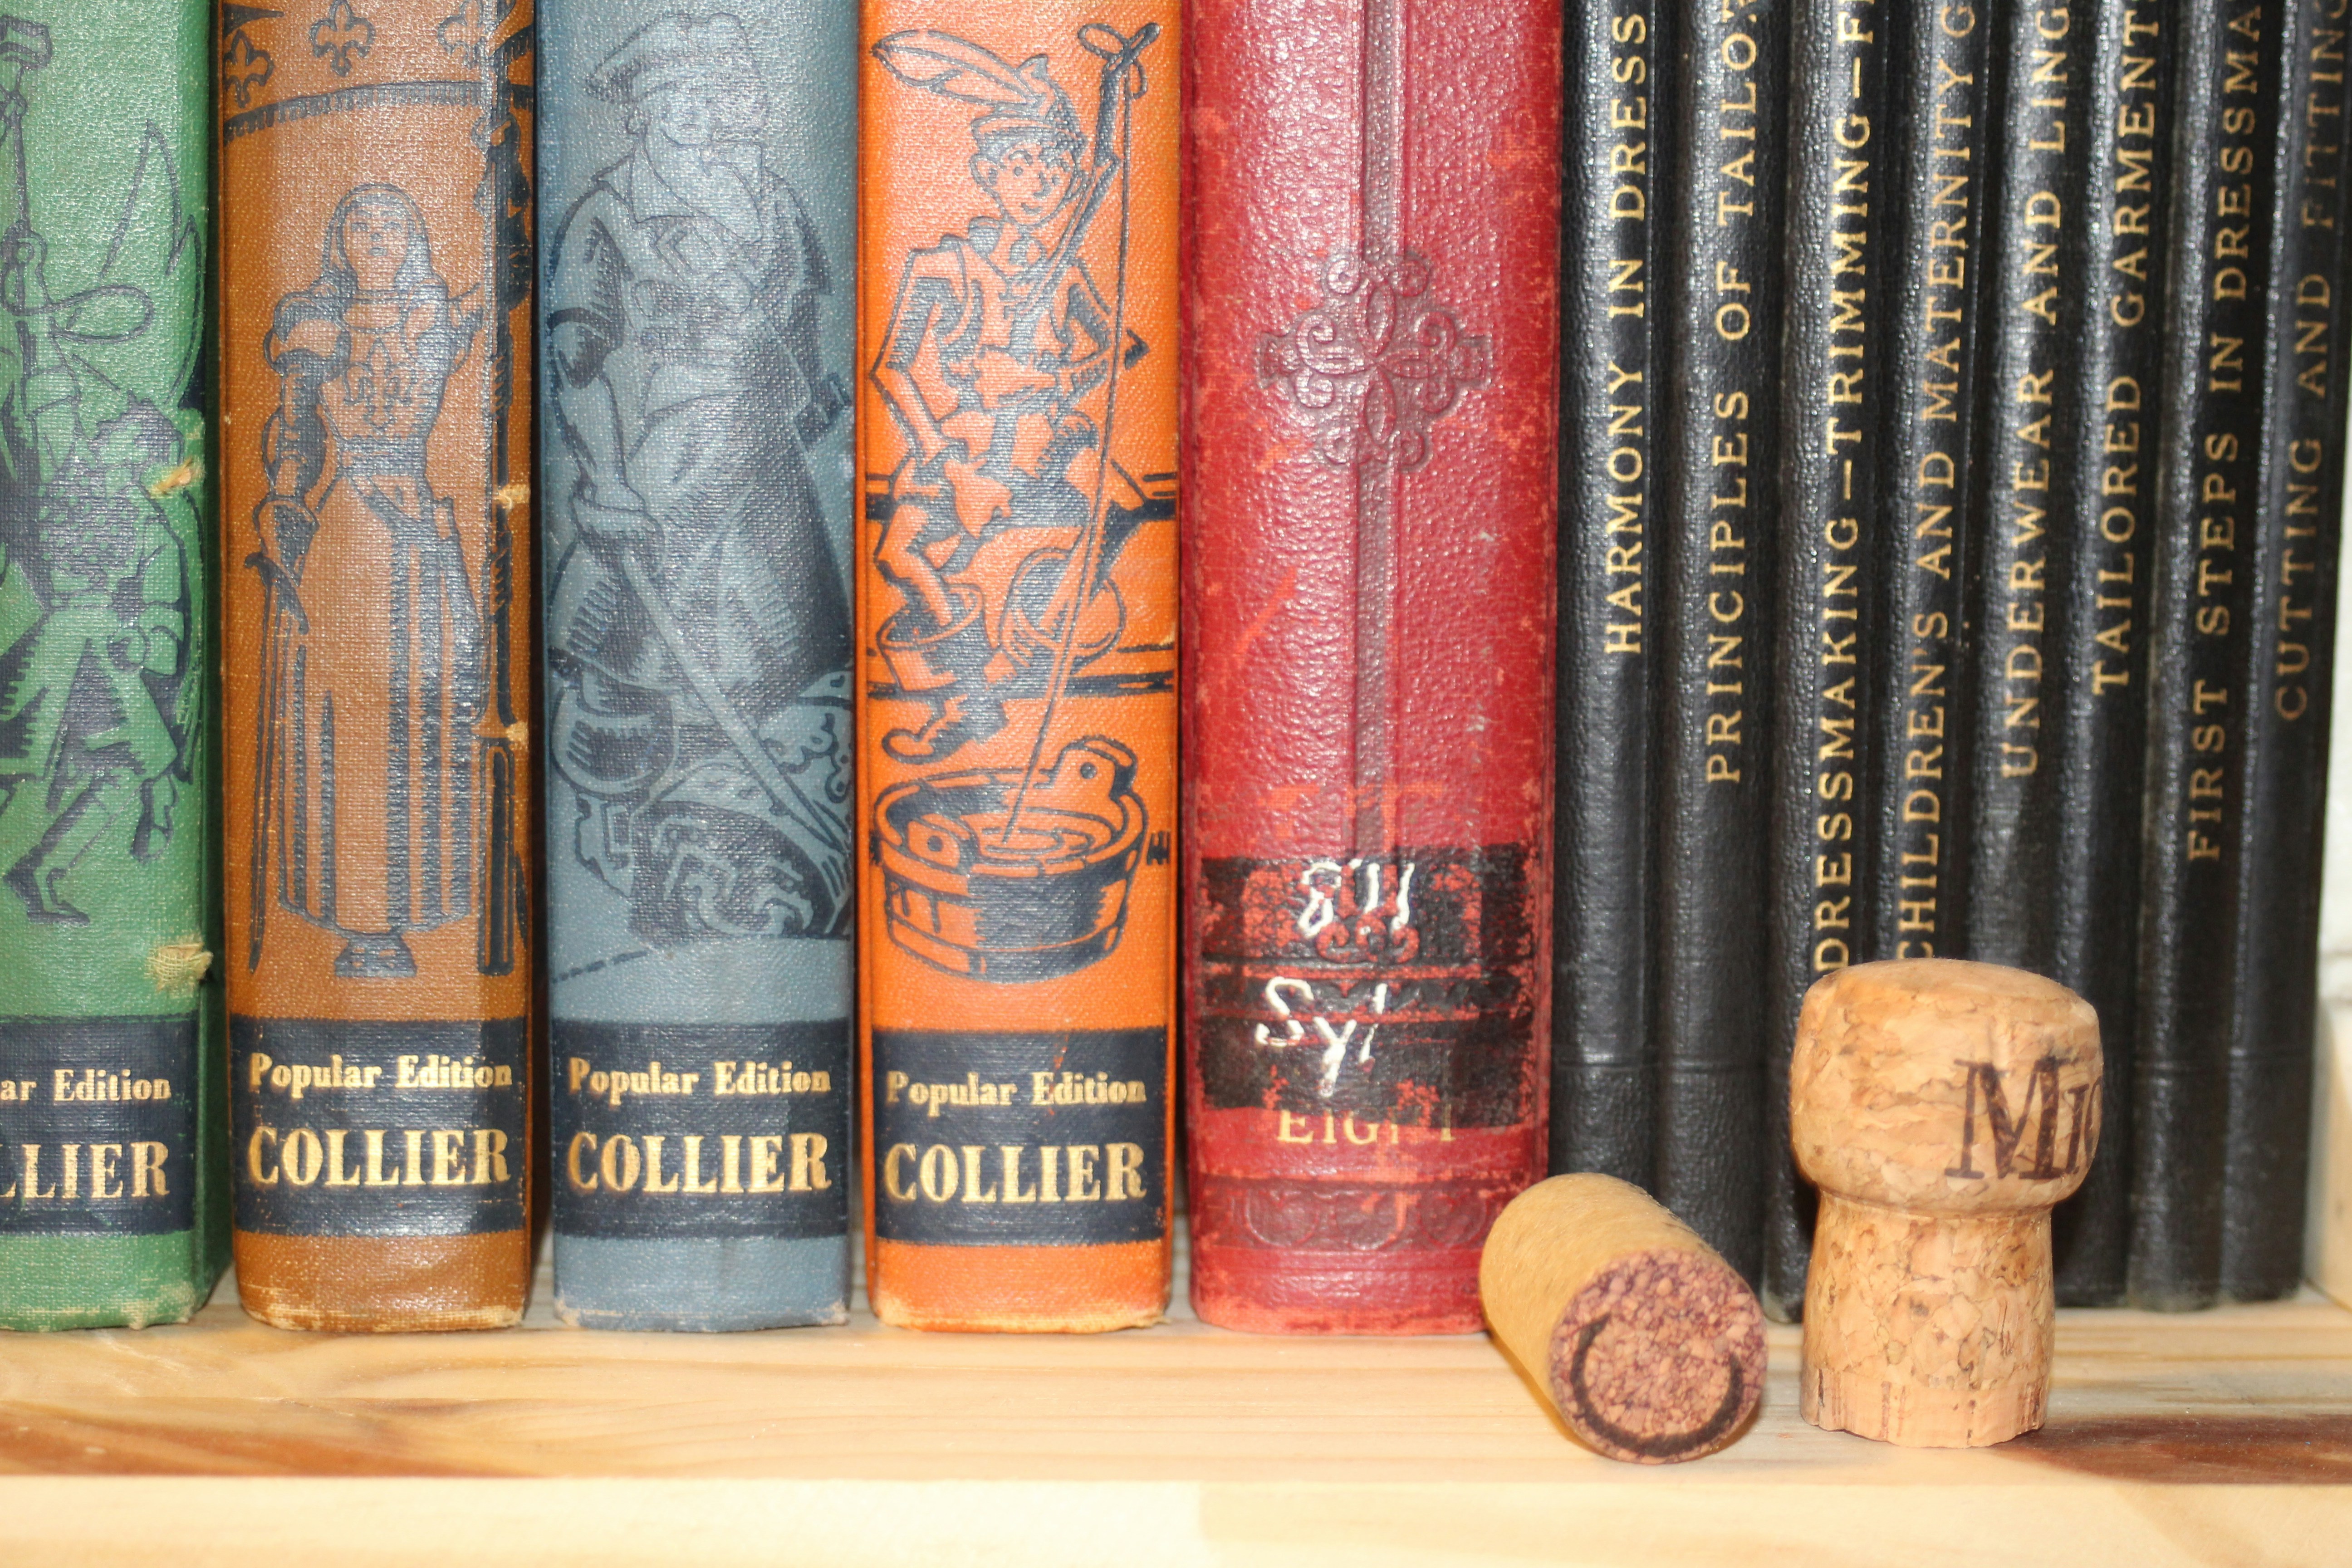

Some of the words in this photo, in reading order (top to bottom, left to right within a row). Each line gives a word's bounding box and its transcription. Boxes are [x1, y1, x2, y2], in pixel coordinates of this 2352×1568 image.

[1609, 14, 1646, 221] DRESS
[2029, 1, 2070, 153] LING
[2110, 1, 2160, 327] GARMENT
[2213, 1, 2262, 301] DRESSMA
[1607, 260, 1644, 318] IN
[1715, 261, 1751, 341] OF
[1922, 59, 1974, 422] MATERNITY
[2022, 191, 2061, 326] AND
[2209, 333, 2244, 392] IN
[2294, 274, 2331, 397] AND
[1604, 361, 1643, 654] HARMONY
[1916, 451, 1956, 580] AND
[2000, 369, 2054, 778] UNDERWEAR
[2092, 375, 2141, 696] TAILORED
[2196, 432, 2239, 635] STEPS
[1705, 390, 1749, 784] PRINCIPLES
[2275, 438, 2323, 720] CUTTING
[2187, 679, 2228, 861] FIRST
[54, 1068, 172, 1102] Edition
[249, 1052, 382, 1098] Popular
[395, 1054, 513, 1089] Edition
[568, 1058, 700, 1105] Popular
[714, 1061, 832, 1095] Edition
[886, 1070, 1017, 1117] Popular
[1030, 1071, 1147, 1106] Edition
[247, 1127, 511, 1187] COLLIER
[567, 1132, 832, 1193] COLLIER
[884, 1142, 1147, 1203] COLLIER
